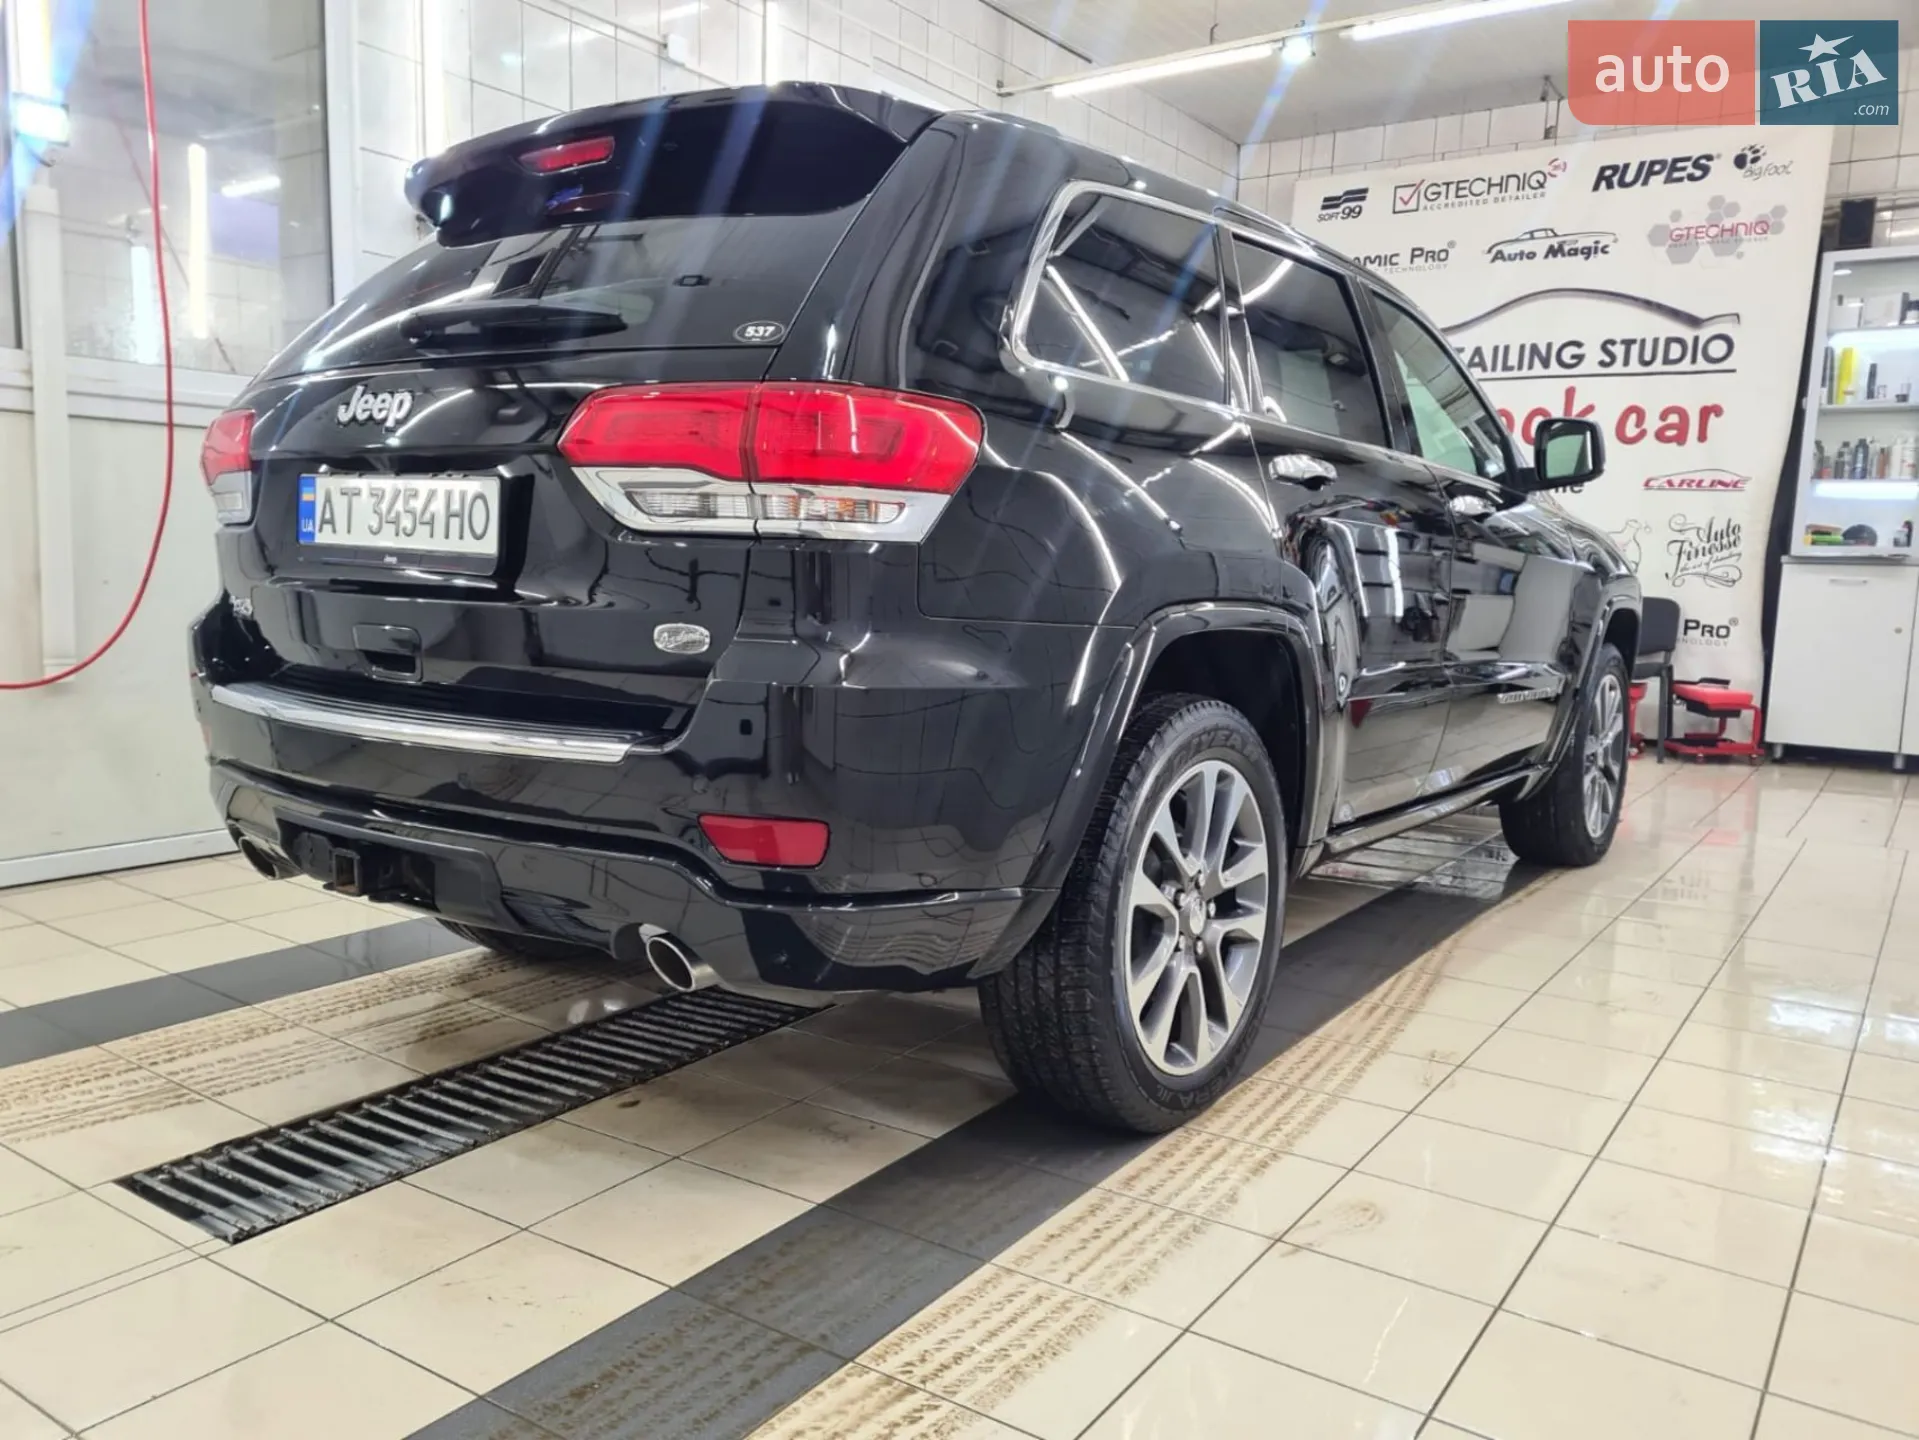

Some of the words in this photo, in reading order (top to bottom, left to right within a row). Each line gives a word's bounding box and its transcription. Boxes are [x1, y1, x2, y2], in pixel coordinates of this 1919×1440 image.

[1424, 170, 1548, 202] GTECHNIQ
[1592, 154, 1715, 192] RUPES
[1490, 248, 1538, 264] Auto
[1543, 240, 1611, 262] Magic
[744, 326, 776, 338] 537
[1598, 333, 1735, 368] STUDIO
[337, 385, 412, 428] Jeep
[1615, 404, 1724, 446] car
[301, 518, 314, 532] UA
[318, 487, 361, 534] AT
[368, 487, 436, 539] 3454
[443, 489, 490, 540] HO
